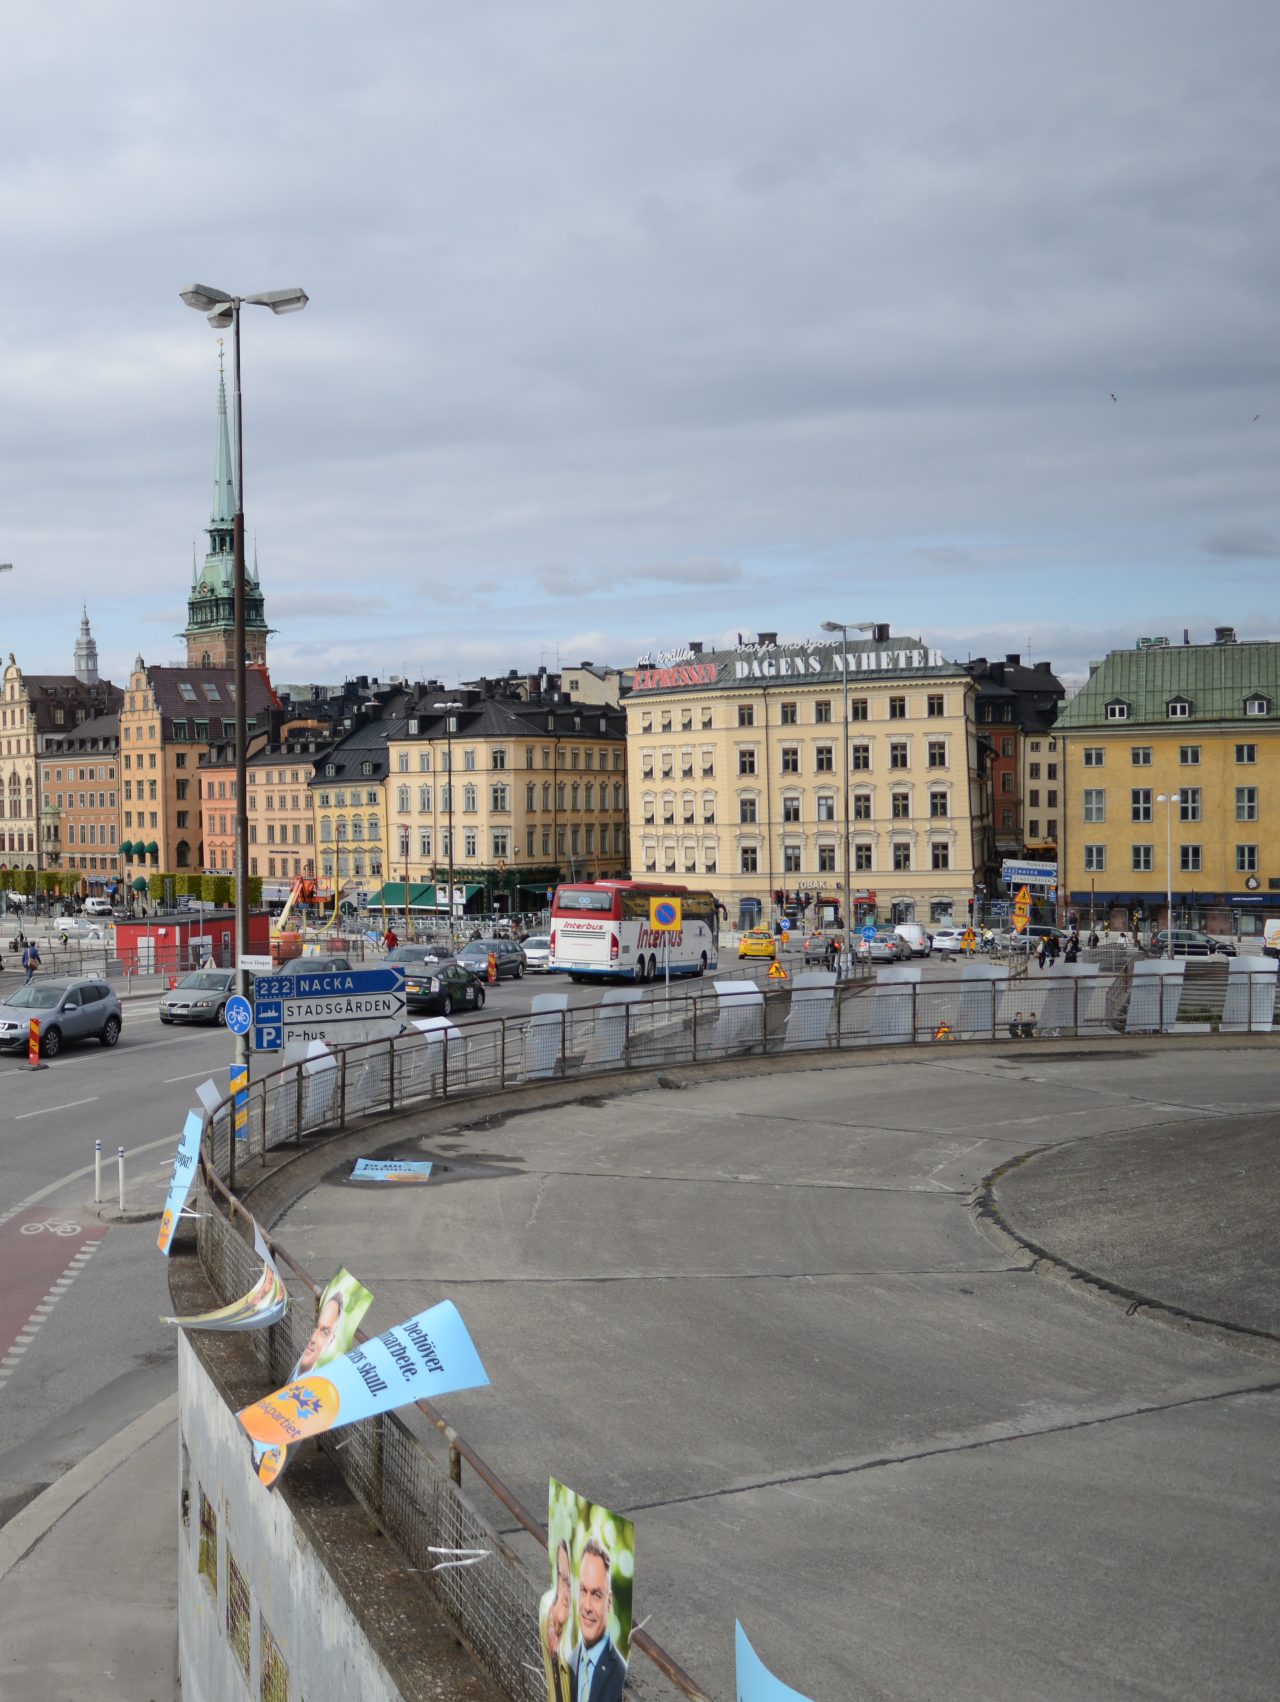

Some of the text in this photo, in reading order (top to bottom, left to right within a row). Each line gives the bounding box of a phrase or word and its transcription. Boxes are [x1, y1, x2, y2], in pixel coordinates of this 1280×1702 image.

[735, 649, 944, 678] DAGENS NYHETER
[632, 662, 719, 692] EXPRESSEN
[563, 921, 604, 931] Interbus
[260, 977, 354, 995] 222 NACKA
[287, 1000, 391, 1017] STADSGÅRDEN
[287, 1030, 326, 1042] P-hus
[402, 1321, 444, 1373] behöver
[357, 1362, 388, 1397] skull.
